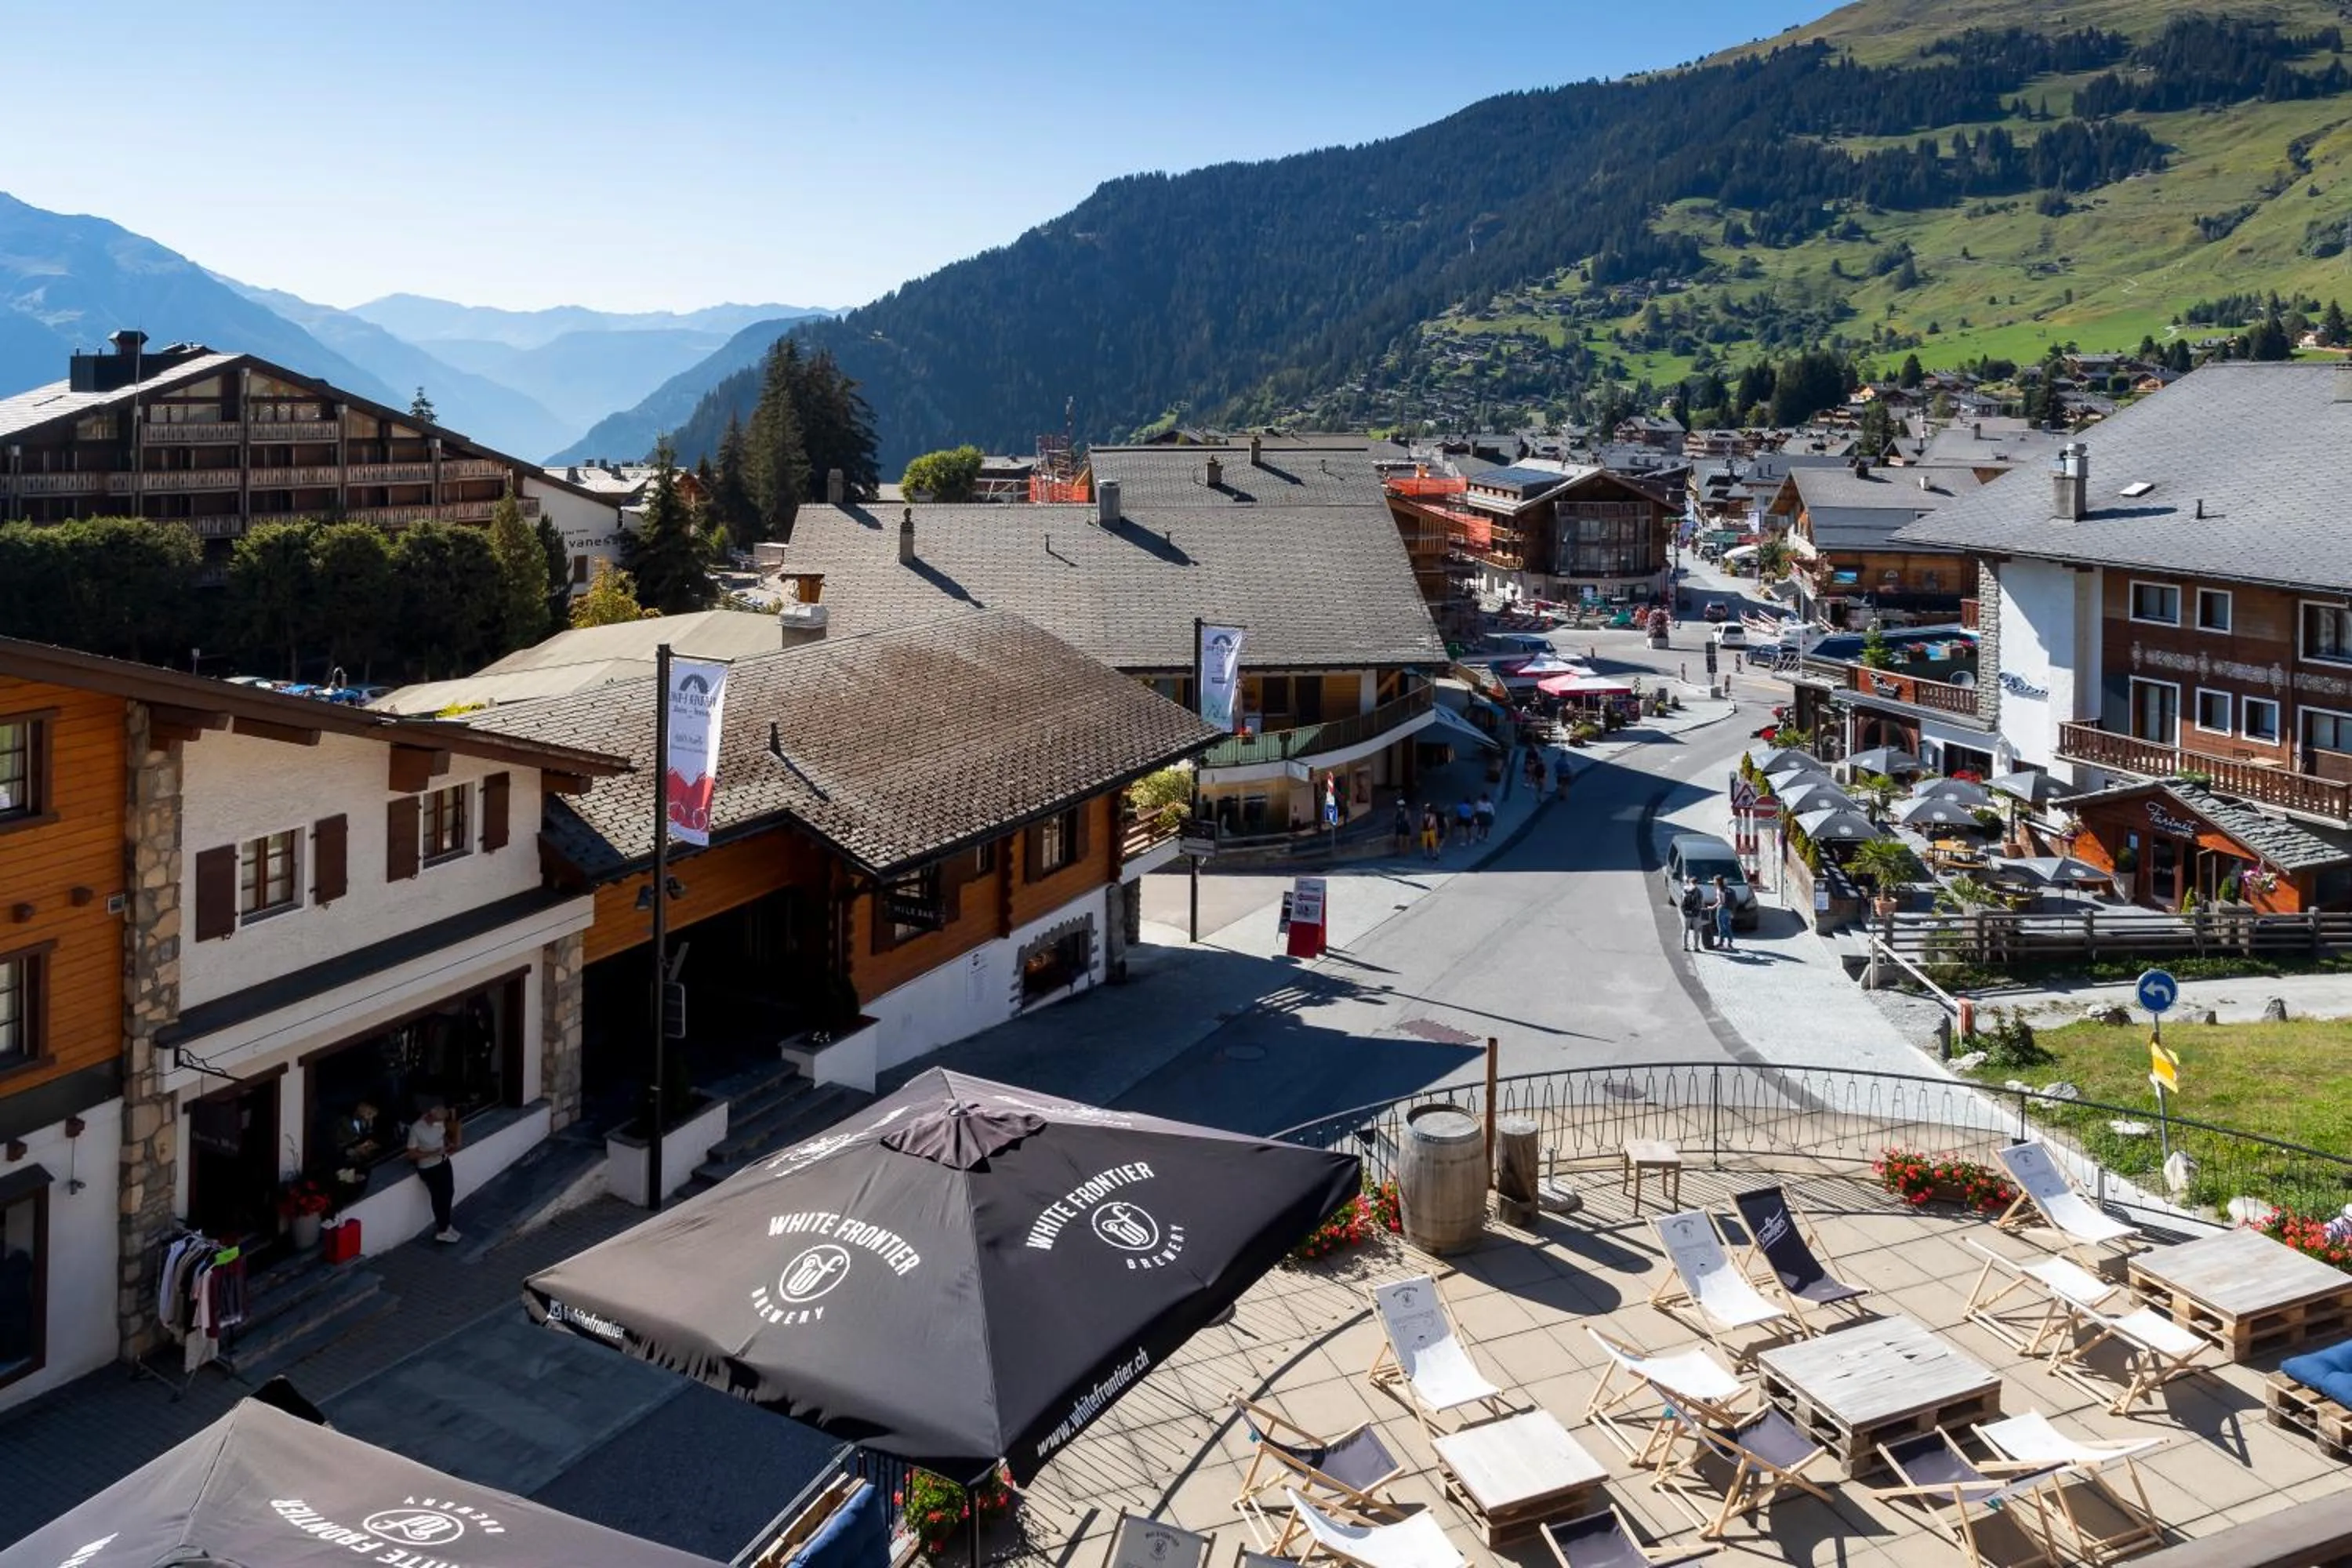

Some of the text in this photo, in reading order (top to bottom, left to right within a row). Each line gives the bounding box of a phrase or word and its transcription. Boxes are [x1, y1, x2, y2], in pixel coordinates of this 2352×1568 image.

[1025, 1161, 1155, 1250] WHITE FRONTIER
[768, 1212, 921, 1276] WHITE FRONTIER
[1126, 1224, 1185, 1269] BREWERY
[1036, 1346, 1150, 1457] www.whitefrontier.ch
[270, 1499, 385, 1553] FRONTIER
